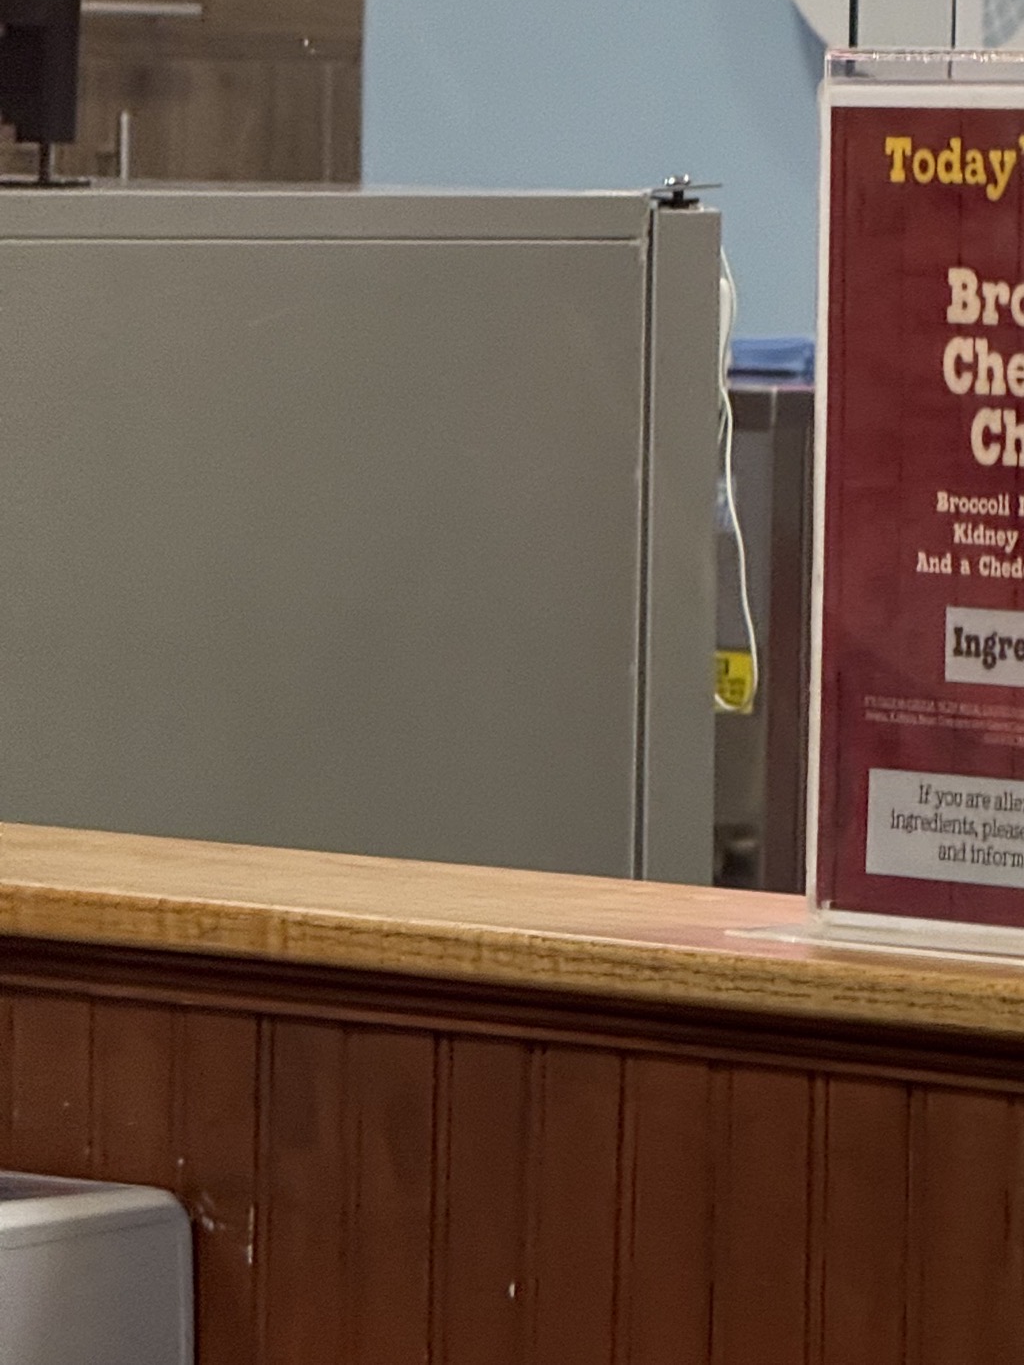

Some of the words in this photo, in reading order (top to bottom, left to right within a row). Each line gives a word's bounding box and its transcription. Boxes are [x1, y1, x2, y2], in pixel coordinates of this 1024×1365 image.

[936, 491, 1010, 516] Broccoli
[953, 523, 1018, 553] Kidney
[916, 552, 952, 573] And
[960, 558, 970, 575] a
[918, 784, 931, 805] If
[935, 790, 963, 809] you
[965, 793, 991, 809] are
[890, 808, 978, 837] ingredients,
[938, 842, 966, 862] and
[971, 843, 1024, 868] inform
